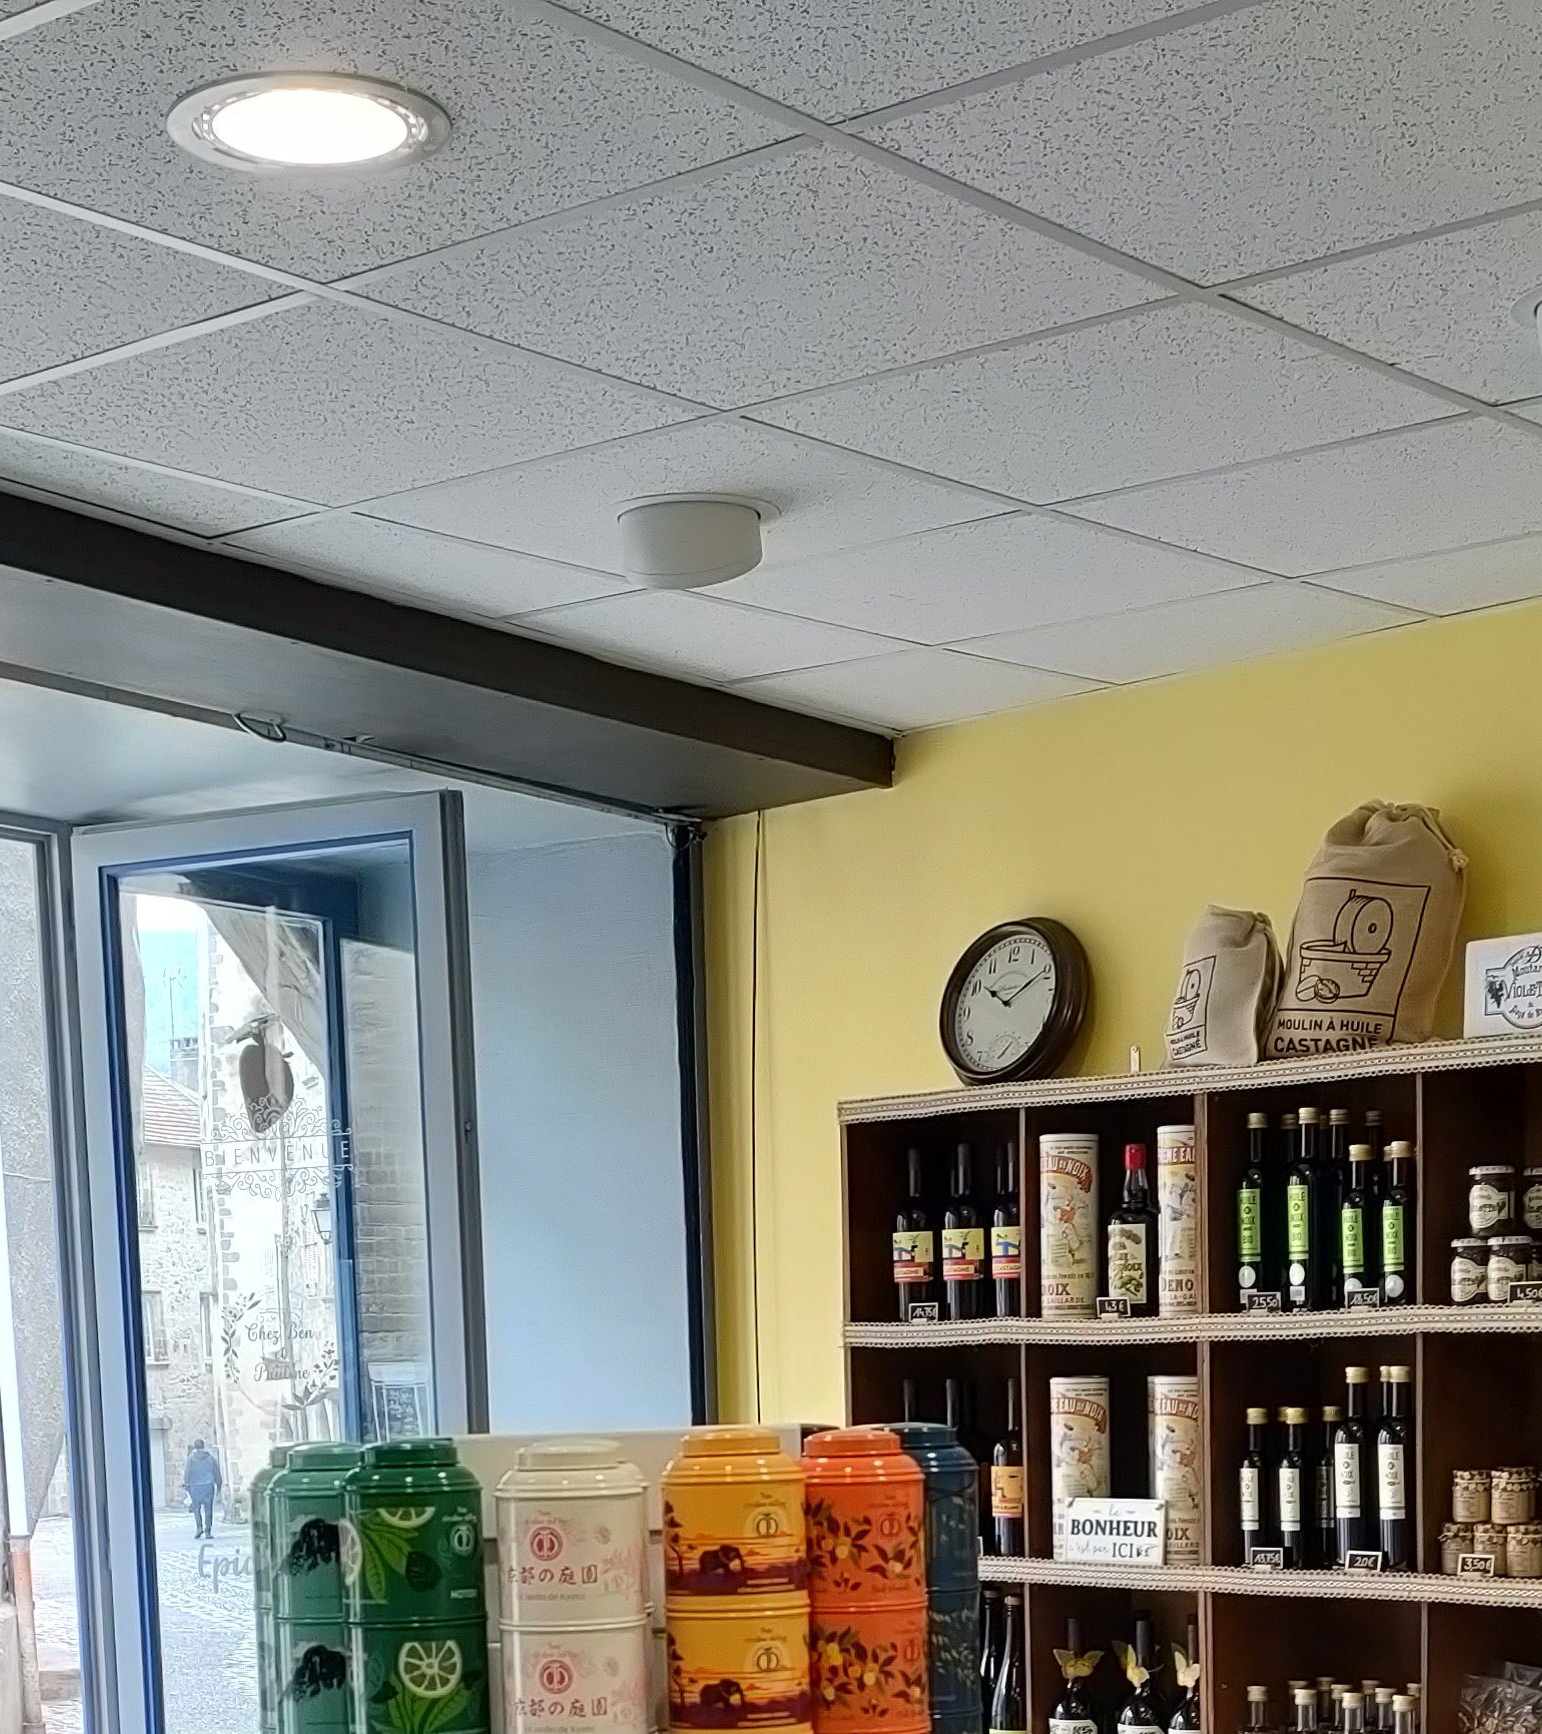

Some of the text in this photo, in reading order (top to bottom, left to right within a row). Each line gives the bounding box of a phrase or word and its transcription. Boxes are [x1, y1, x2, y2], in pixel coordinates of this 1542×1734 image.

[1008, 946, 1020, 963] 12
[989, 958, 997, 974] 11
[971, 980, 981, 996] 10
[1277, 1015, 1383, 1034] MOULIN À HUILE
[205, 1140, 349, 1166] BIENVENUE
[245, 1322, 314, 1345] Chez Ben
[1084, 1403, 1106, 1421] NOIX
[1070, 1519, 1158, 1537] BONHEUR
[1112, 1542, 1134, 1558] ICI
[1464, 1559, 1492, 1571] 3,50€
